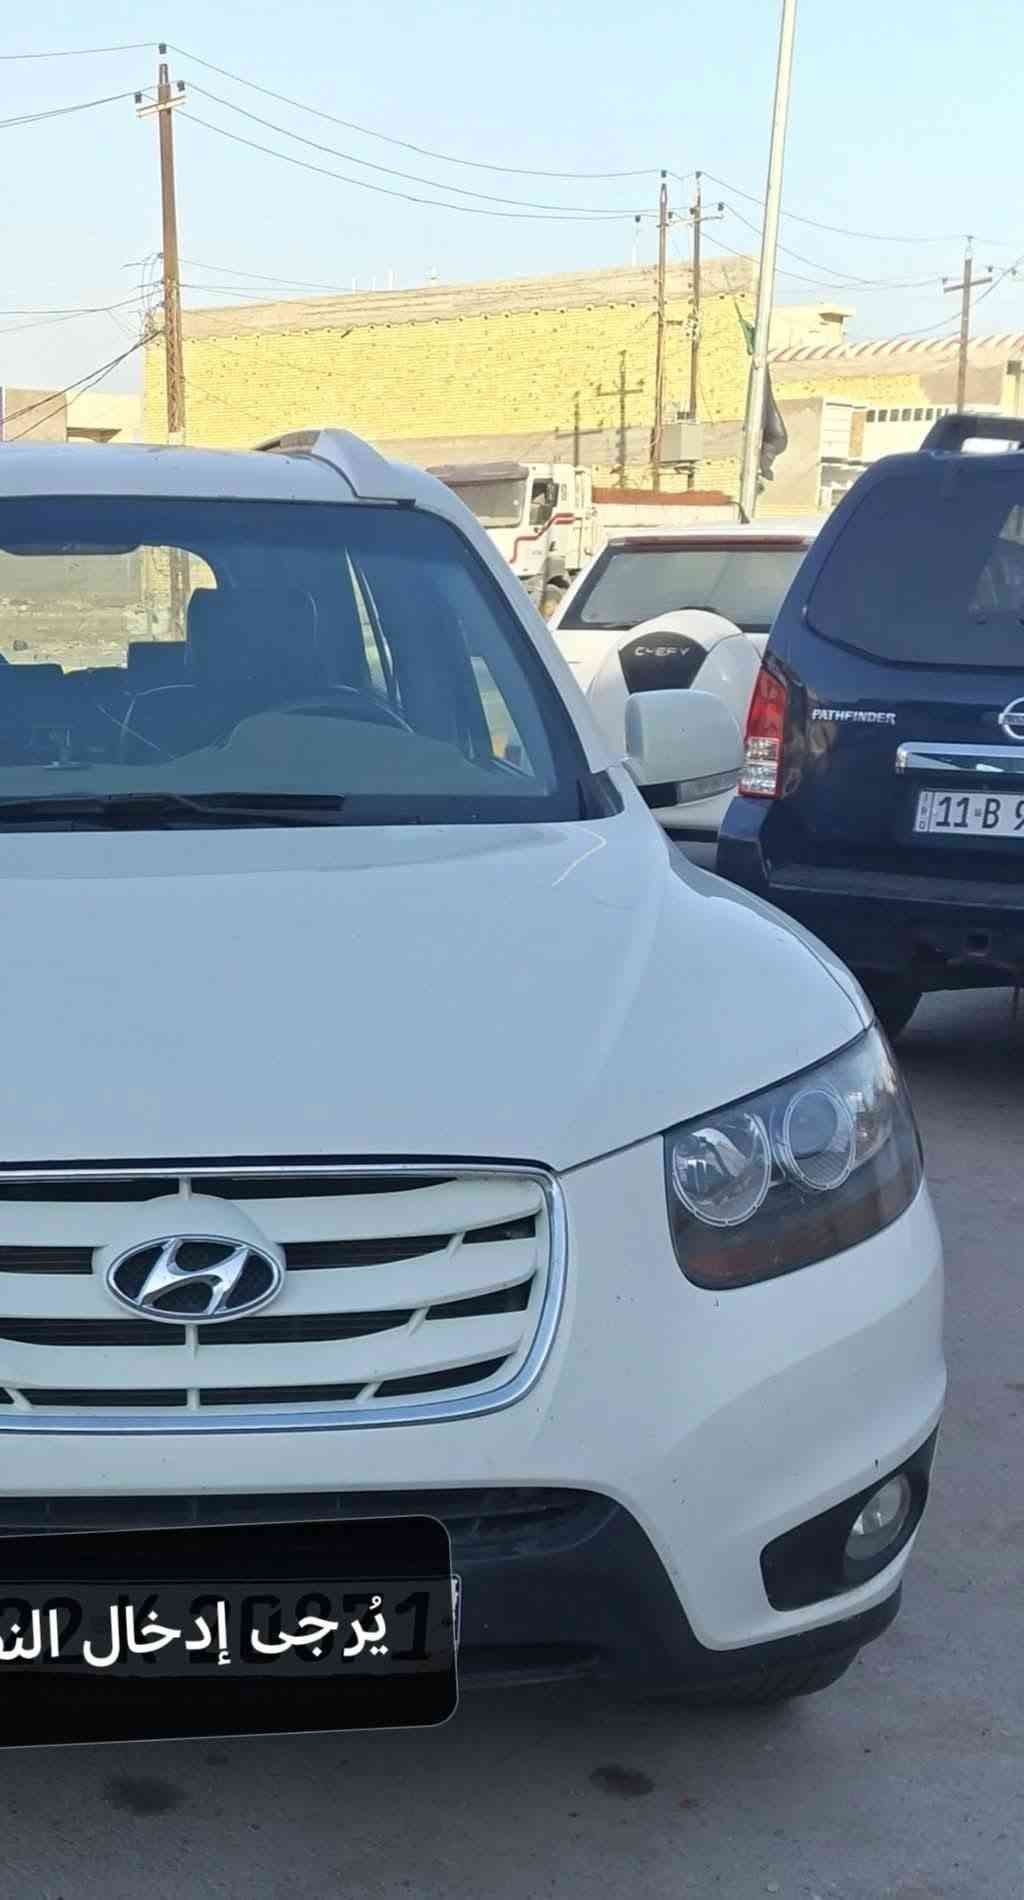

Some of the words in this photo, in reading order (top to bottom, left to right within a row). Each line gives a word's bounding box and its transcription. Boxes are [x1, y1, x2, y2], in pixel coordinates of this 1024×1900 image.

[811, 709, 896, 725] PATHFINDER
[935, 796, 970, 828] 11
[982, 798, 1001, 829] B
